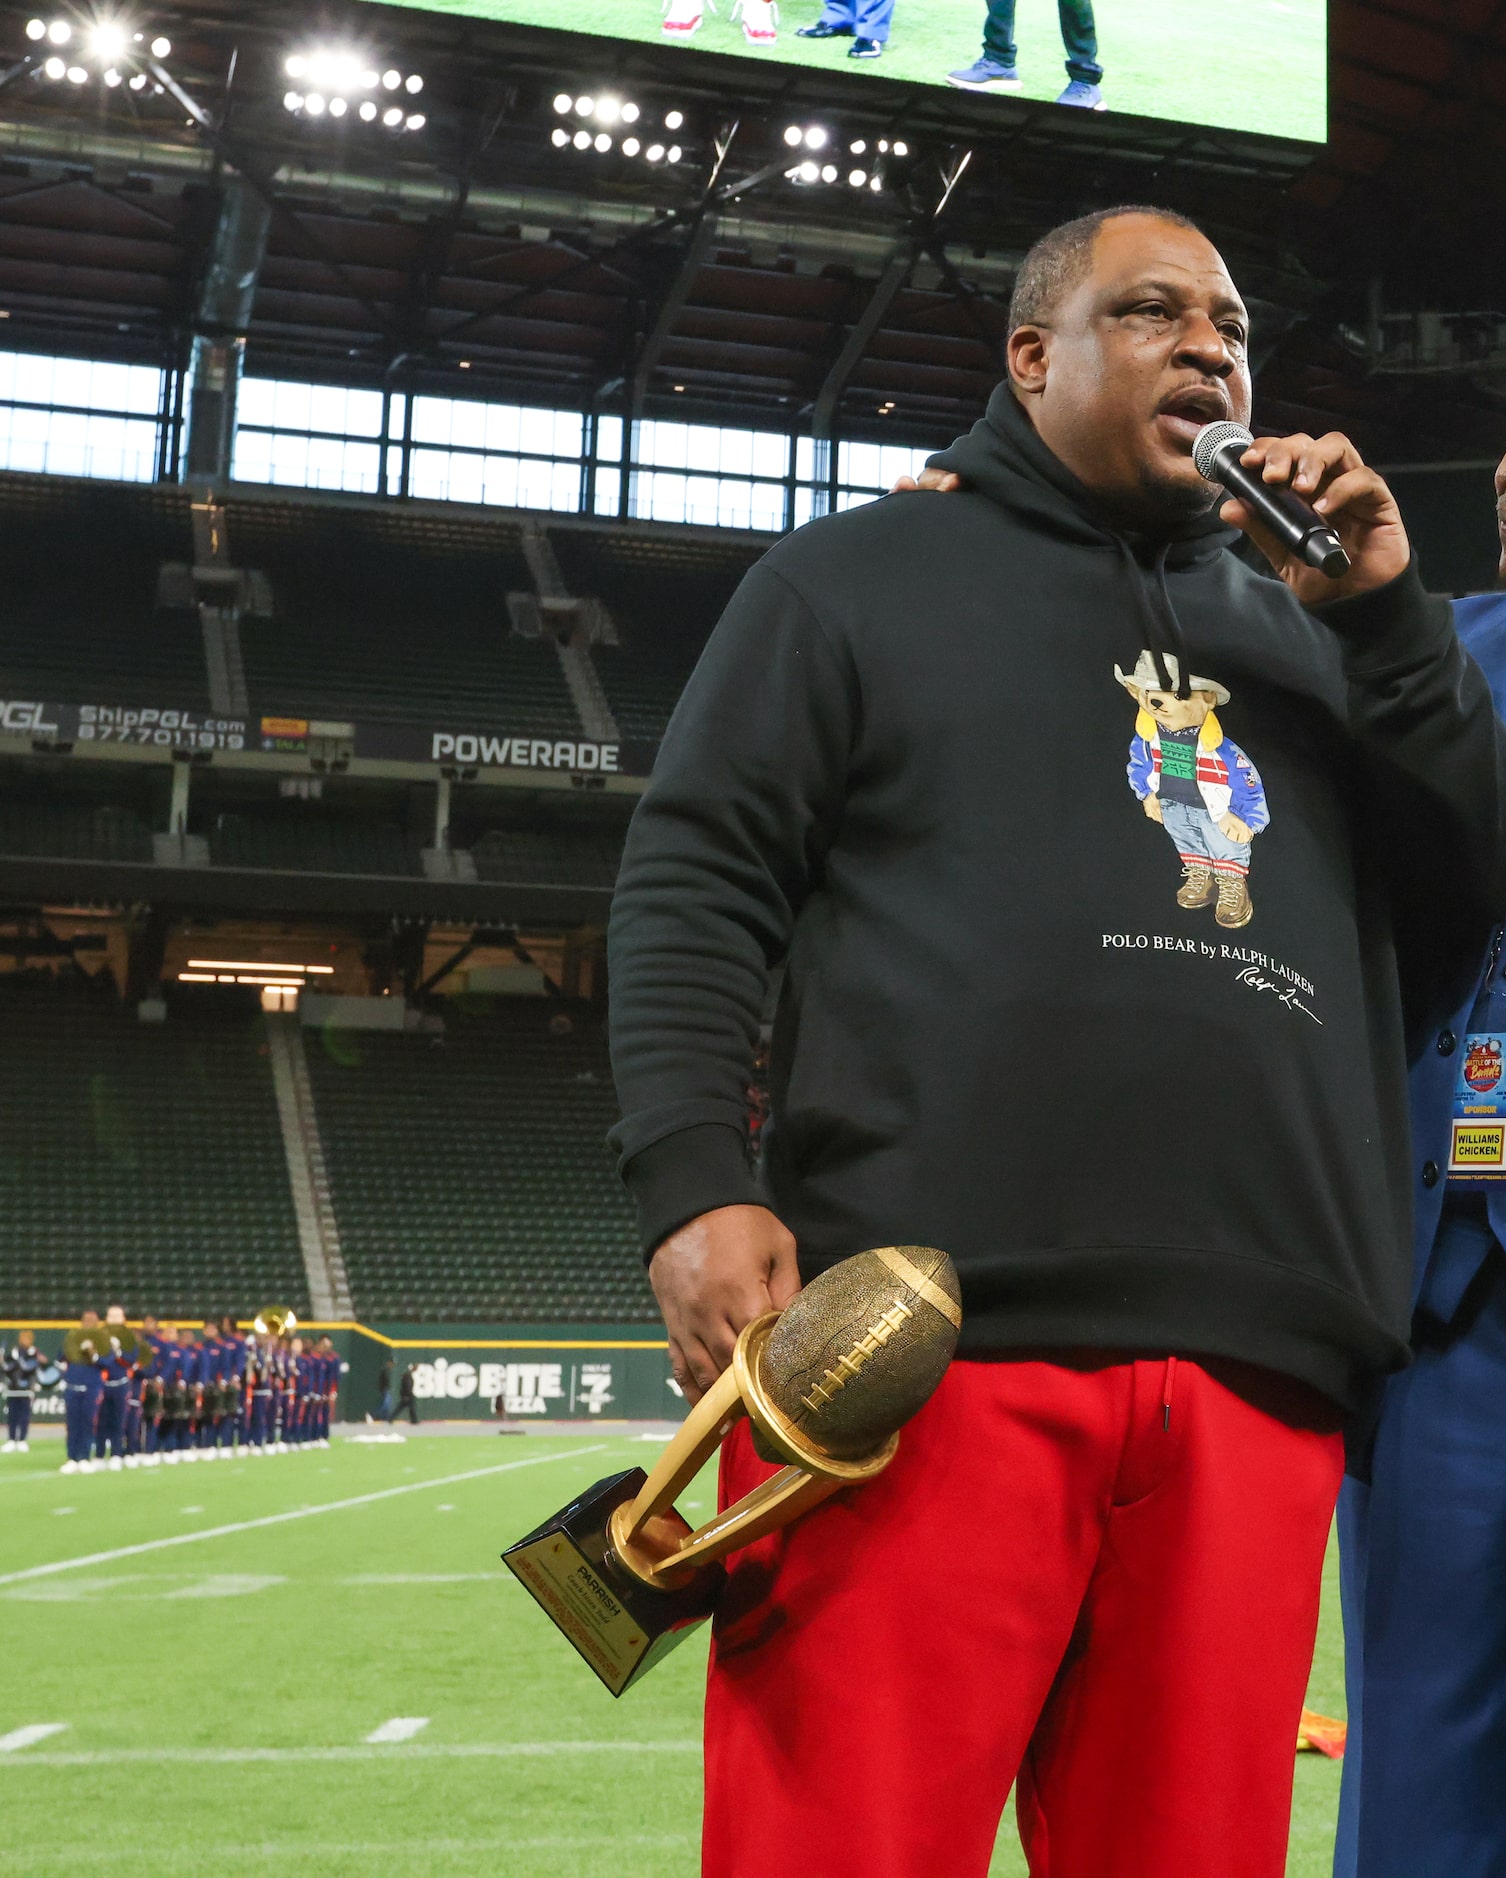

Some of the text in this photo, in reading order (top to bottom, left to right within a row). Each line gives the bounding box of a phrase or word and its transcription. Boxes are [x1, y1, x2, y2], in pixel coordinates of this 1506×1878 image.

[78, 723, 245, 750] 877.701.1919
[432, 732, 620, 771] POWERADE
[1101, 934, 1315, 997] POLO BEAR by RALPH LAUREN
[1463, 1105, 1497, 1114] SPONSOR
[1457, 1134, 1500, 1144] WILLIAMS
[478, 1363, 565, 1398] BITE
[576, 1565, 621, 1617] PARRISH
